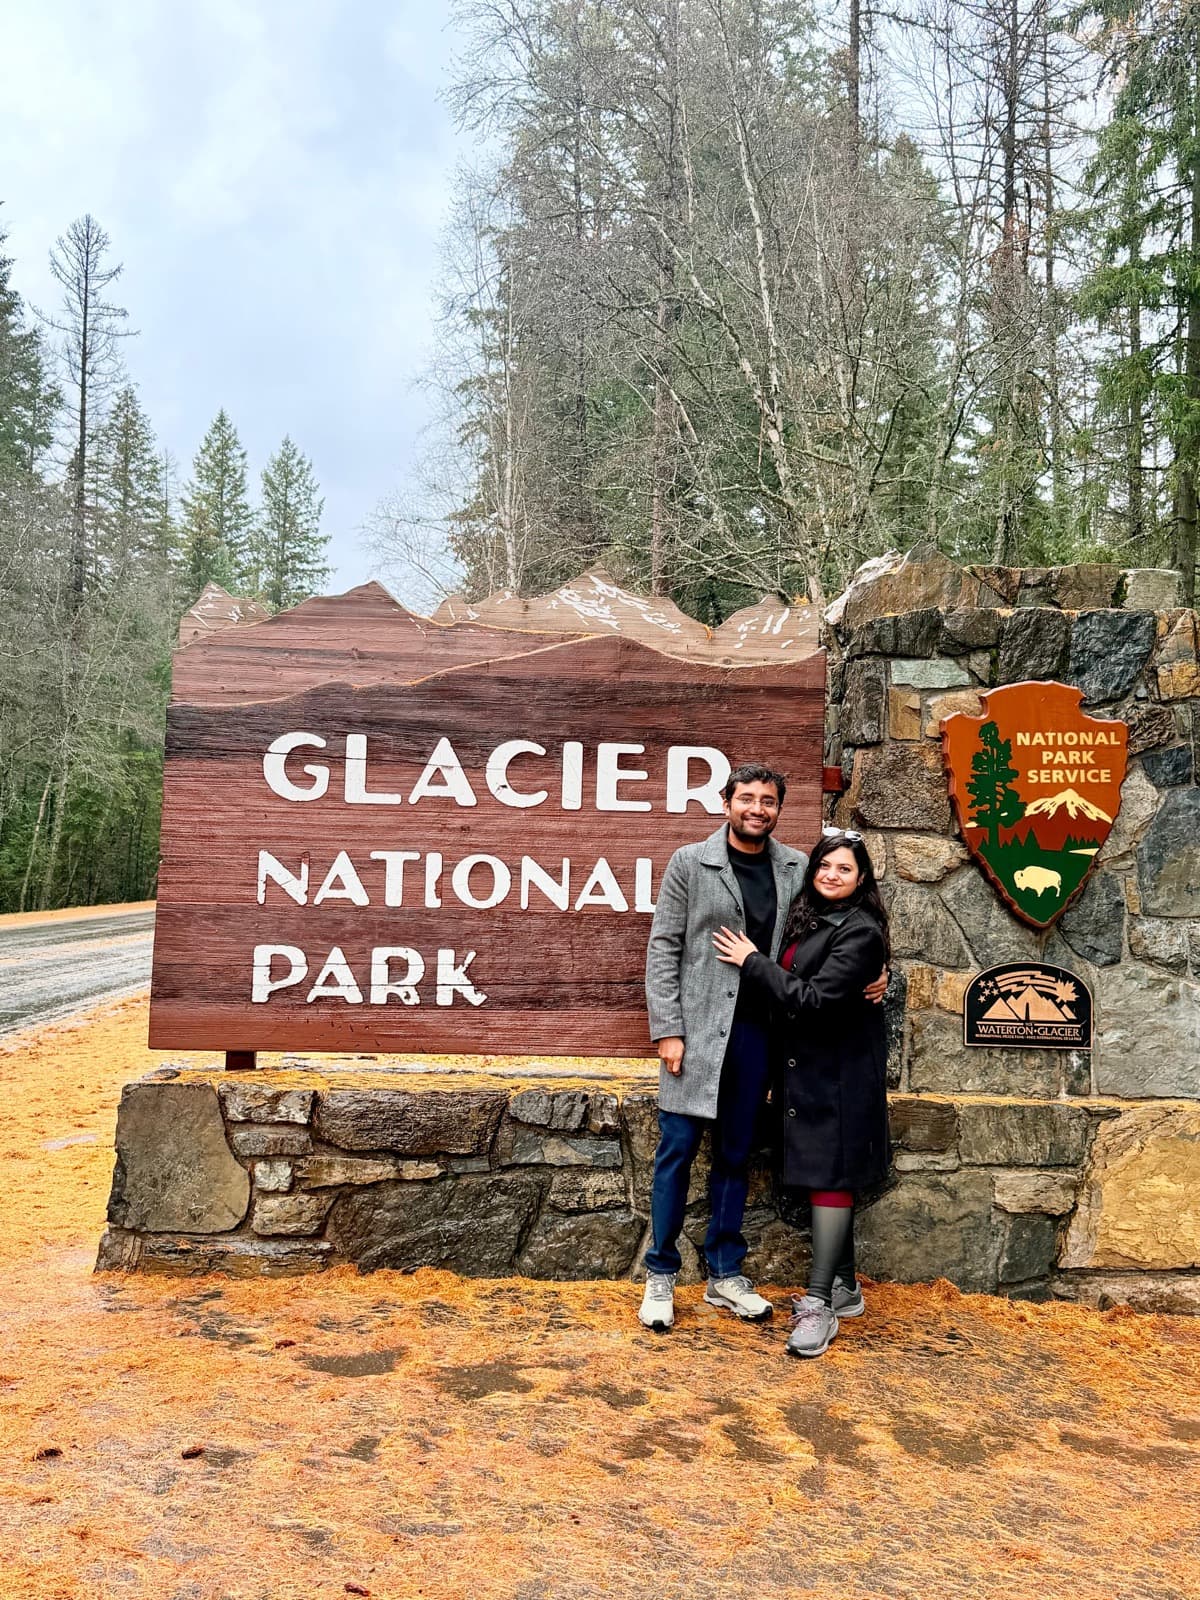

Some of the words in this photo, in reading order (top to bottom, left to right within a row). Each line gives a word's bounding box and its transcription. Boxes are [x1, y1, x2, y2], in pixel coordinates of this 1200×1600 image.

[1016, 731, 1121, 746] NATIONAL
[262, 731, 731, 814] GLACIER
[1027, 769, 1112, 784] SERVICE
[1042, 751, 1095, 765] PARK
[256, 850, 656, 913] NATIONAL
[251, 945, 488, 1006] PARK
